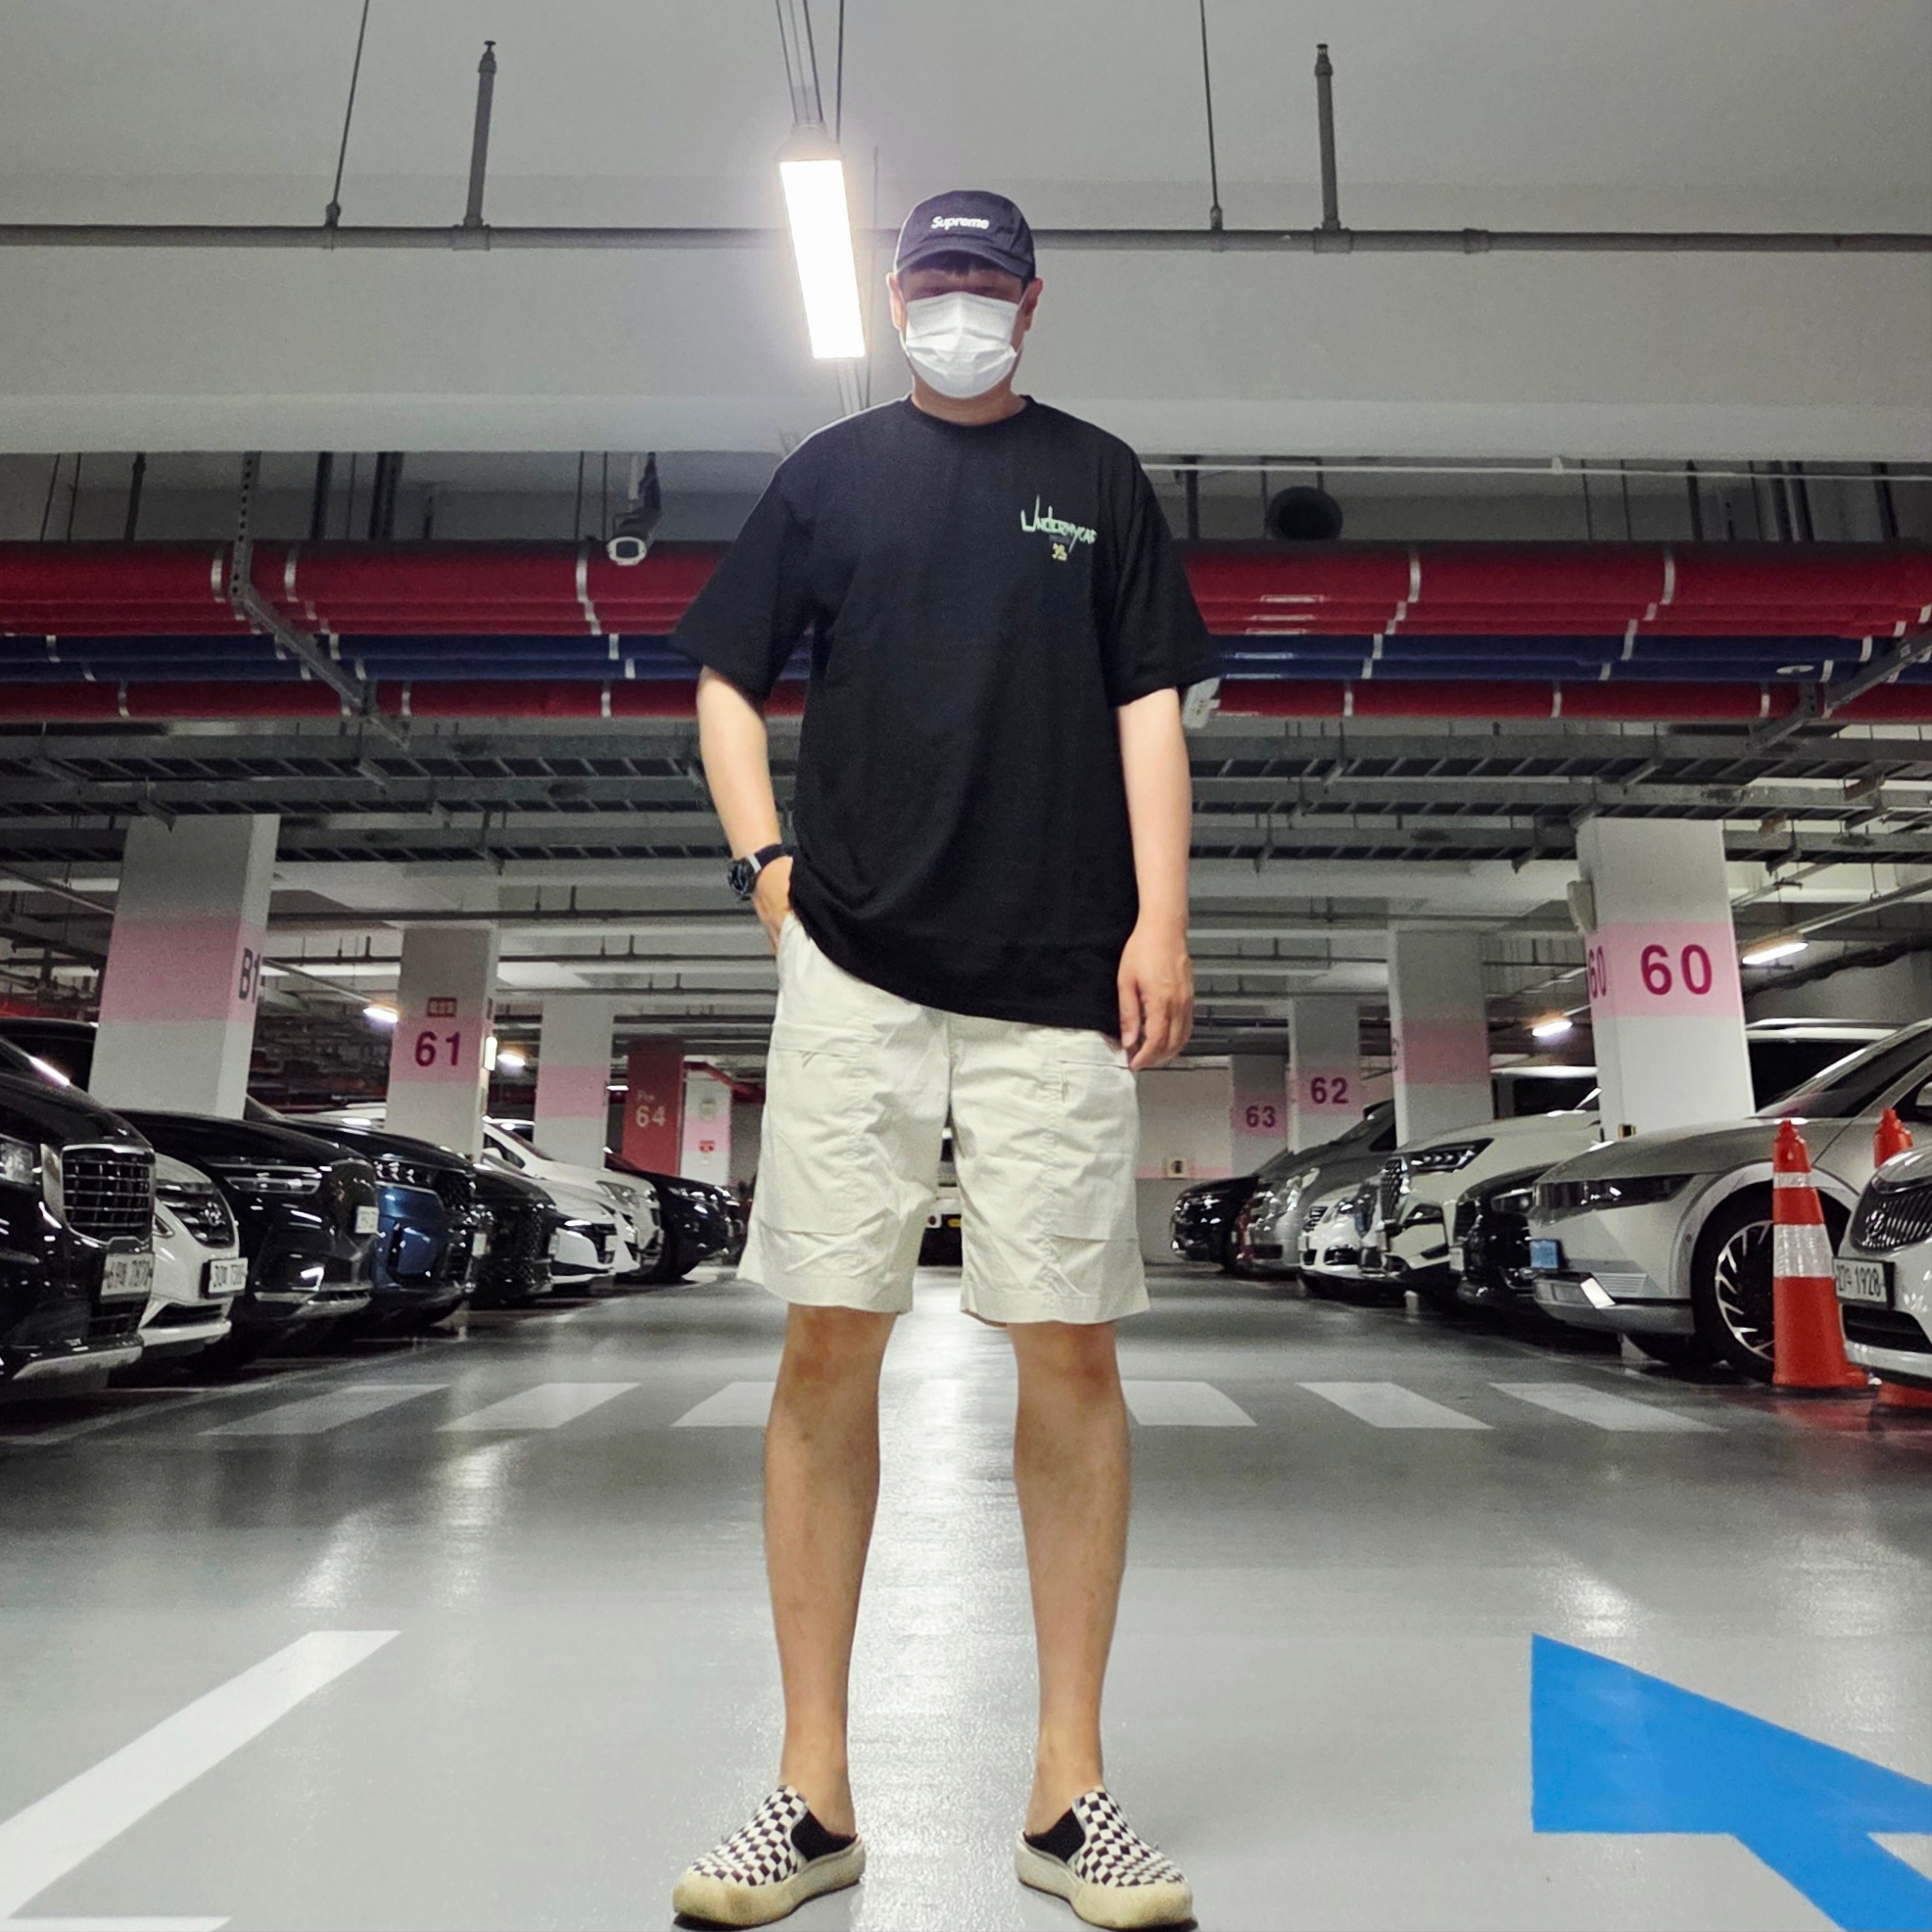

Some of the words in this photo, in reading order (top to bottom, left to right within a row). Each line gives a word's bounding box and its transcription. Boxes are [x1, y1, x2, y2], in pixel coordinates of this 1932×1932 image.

[931, 216, 989, 230] Supreme
[238, 947, 260, 1004] B1
[1588, 945, 1607, 999] 60
[1640, 944, 1713, 995] 60
[415, 1031, 460, 1066] 61
[1311, 1077, 1348, 1105] 62
[636, 1106, 666, 1128] 64
[1246, 1106, 1276, 1128] 63
[1855, 1265, 1881, 1297] 1928
